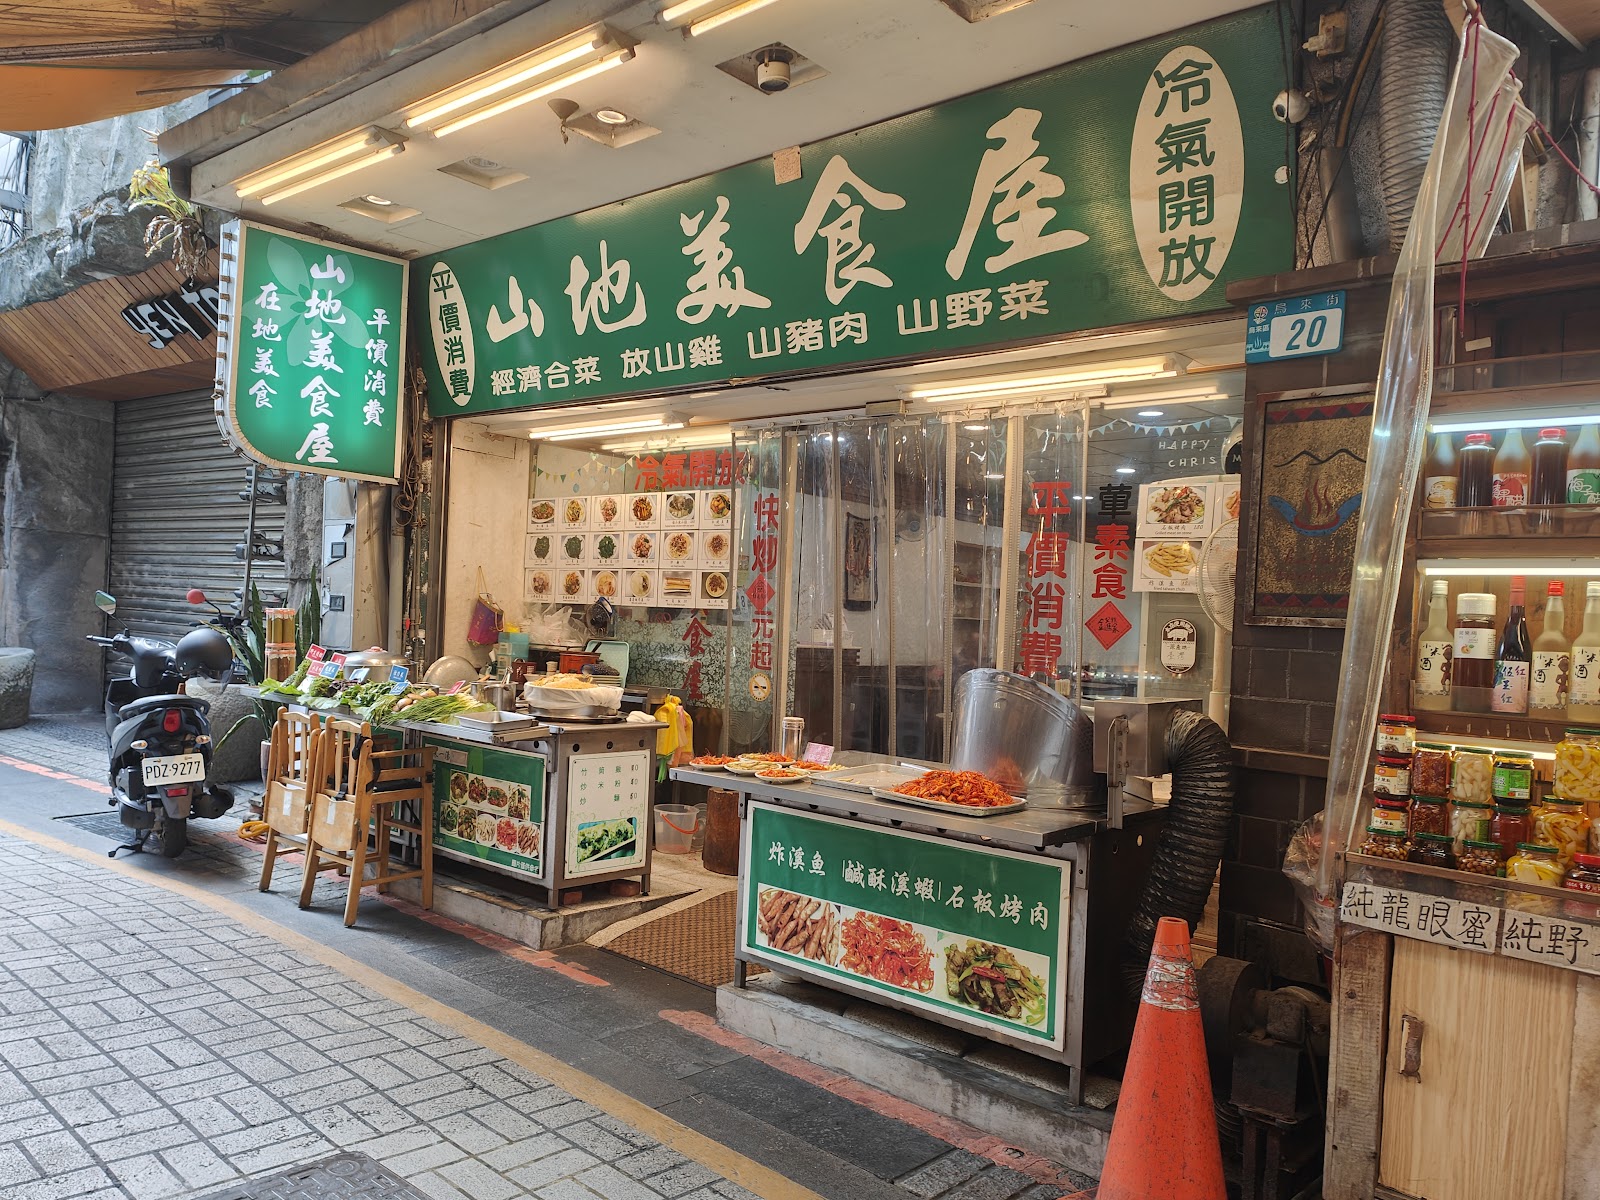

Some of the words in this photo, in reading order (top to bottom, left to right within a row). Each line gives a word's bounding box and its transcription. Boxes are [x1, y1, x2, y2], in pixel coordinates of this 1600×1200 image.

[1153, 58, 1217, 288] 冷氣開放
[486, 107, 1090, 343] 山地美食屋
[248, 281, 282, 409] 在地美食
[431, 269, 471, 398] 平價消費
[490, 355, 602, 396] 經濟合菜
[620, 334, 724, 379] 放山雞
[747, 311, 869, 359] 山豬肉
[896, 279, 1050, 336] 山野菜
[1274, 293, 1339, 315] 烏來街
[1285, 315, 1328, 351] 20
[295, 254, 347, 464] 山地美食屋
[363, 308, 391, 427] 平價消費
[634, 449, 746, 490] 冷氣開放
[1158, 438, 1210, 451] HAPPY
[751, 492, 779, 573] 快炒
[1091, 483, 1132, 600] 葷素食
[1020, 481, 1072, 680] 平價消費
[749, 610, 774, 671] 元起
[1534, 655, 1555, 683] 小米酒
[1575, 648, 1598, 679] 小米酒
[768, 841, 826, 876] 炸溪魚
[844, 858, 936, 903] 鹹酥溪蝦
[945, 884, 1049, 931] 石板烤肉
[1341, 886, 1493, 949] 純龍眼蜜
[1503, 917, 1600, 965] 純野
